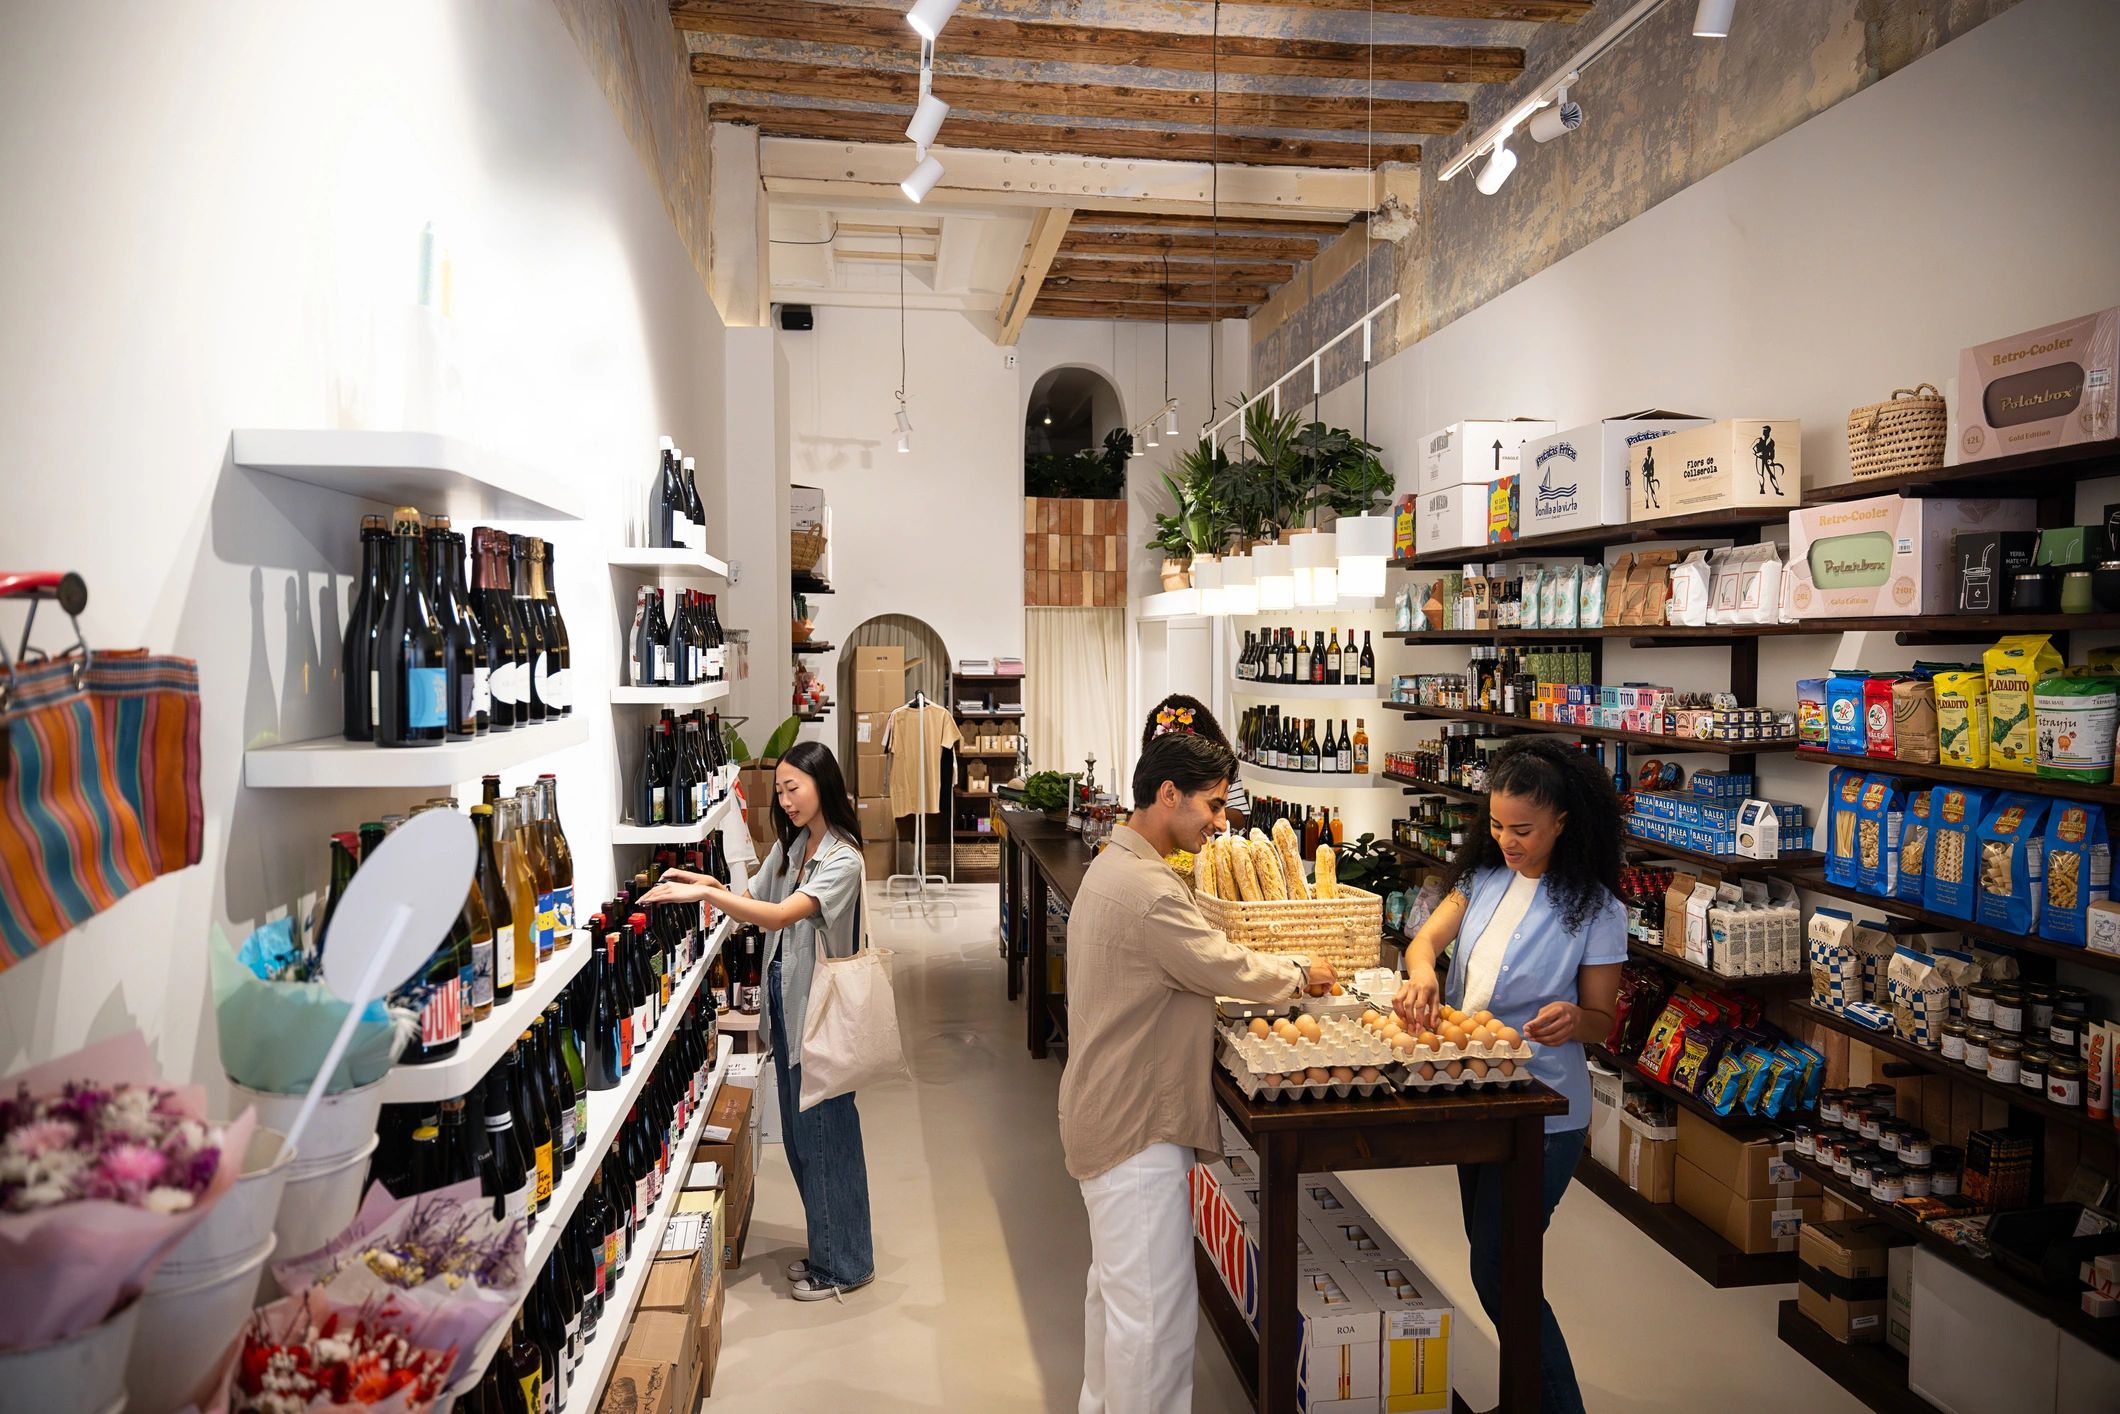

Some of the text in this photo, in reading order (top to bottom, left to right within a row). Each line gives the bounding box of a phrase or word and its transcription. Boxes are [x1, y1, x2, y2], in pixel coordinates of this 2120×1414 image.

[1992, 337, 2074, 367] Retro-Cooler
[2001, 389, 2072, 412] Polarbox
[1625, 431, 1660, 448] Patatas
[2025, 430, 2052, 441] Edition
[1535, 442, 1578, 471] Patatas Fritas
[1686, 457, 1714, 470] Flors de
[1683, 465, 1718, 479] Collserola
[1819, 507, 1889, 526] Retro-Cooler
[1823, 558, 1886, 574] Polarbox
[1539, 686, 1550, 698] TITO
[1554, 687, 1565, 698] TITO
[1988, 679, 2030, 694] PLAYADITO
[1568, 688, 1581, 700] TITO
[1602, 690, 1616, 703] TITO
[1620, 693, 1635, 705] TITO
[1639, 693, 1653, 706] TITO
[1938, 699, 1969, 709] PLAYADITO
[1693, 776, 1713, 787] BALEA
[1636, 795, 1653, 805] BALEA
[1654, 799, 1674, 810] BALEA
[1678, 804, 1698, 815] BALEA
[1704, 809, 1725, 820] BALEA
[1647, 821, 1666, 833] BALEA
[1668, 827, 1687, 838] BALEA
[1692, 832, 1712, 843] BALEA
[1337, 1326, 1356, 1334] ROA
